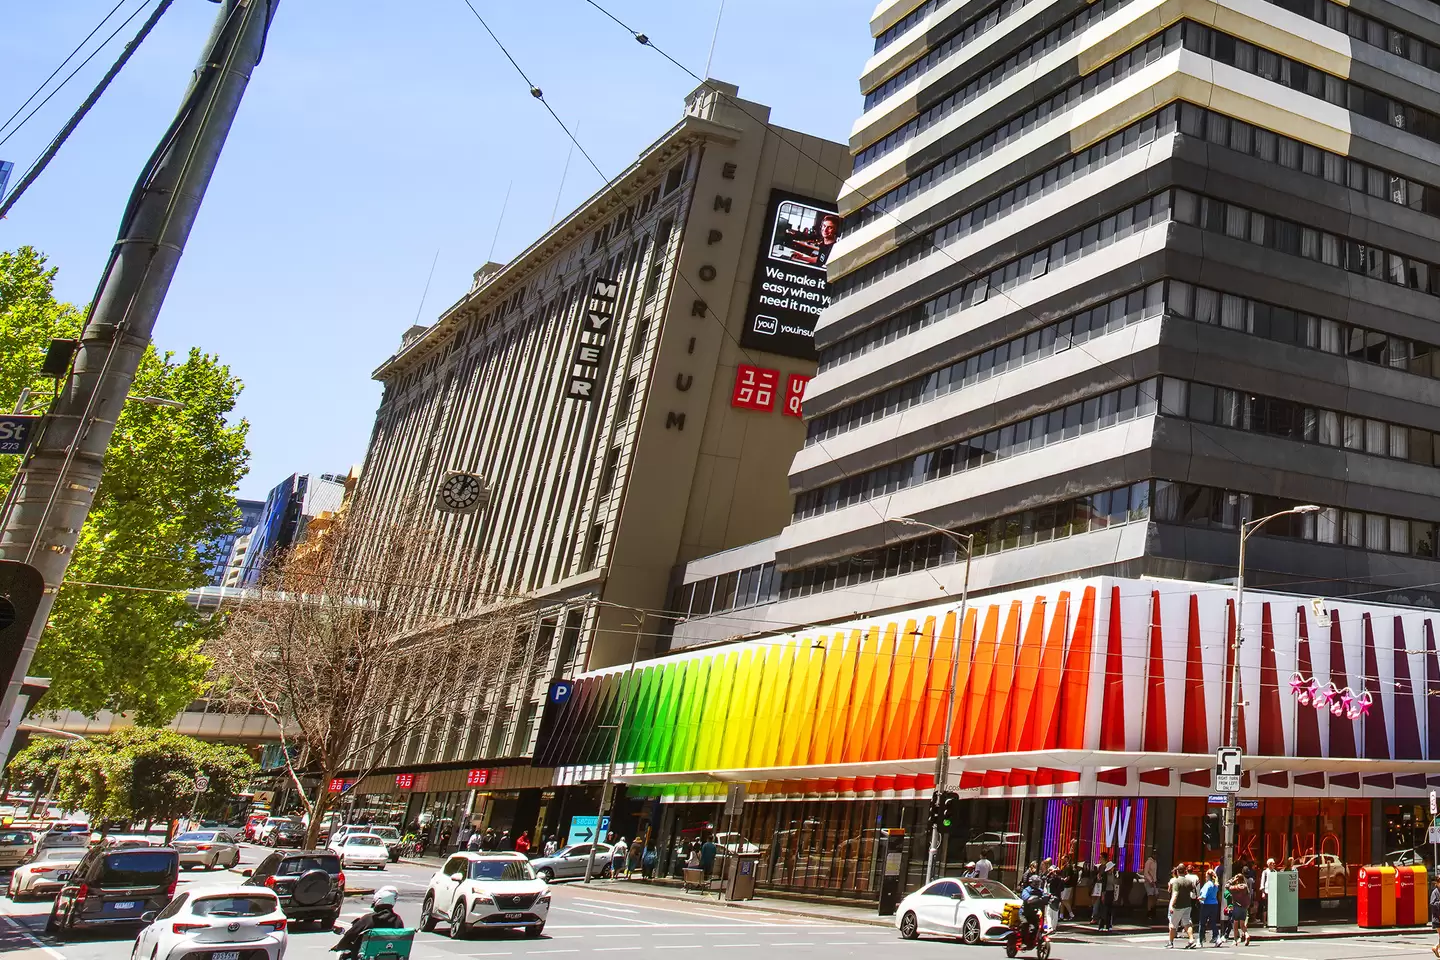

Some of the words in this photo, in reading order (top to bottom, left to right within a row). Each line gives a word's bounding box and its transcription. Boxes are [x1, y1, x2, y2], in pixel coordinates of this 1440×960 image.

[766, 266, 784, 280] We
[786, 274, 816, 287] make
[817, 279, 826, 289] it
[665, 162, 737, 431] EMPORIUM
[762, 282, 789, 296] easy
[790, 288, 820, 302] when
[759, 295, 788, 308] need
[789, 300, 798, 310] it
[799, 304, 825, 315] mos
[757, 320, 775, 329] youi
[570, 282, 617, 396] MYER
[0, 421, 25, 440] St
[0, 442, 20, 450] 273
[555, 686, 567, 700] P
[601, 818, 609, 829] P
[1104, 806, 1132, 848] W
